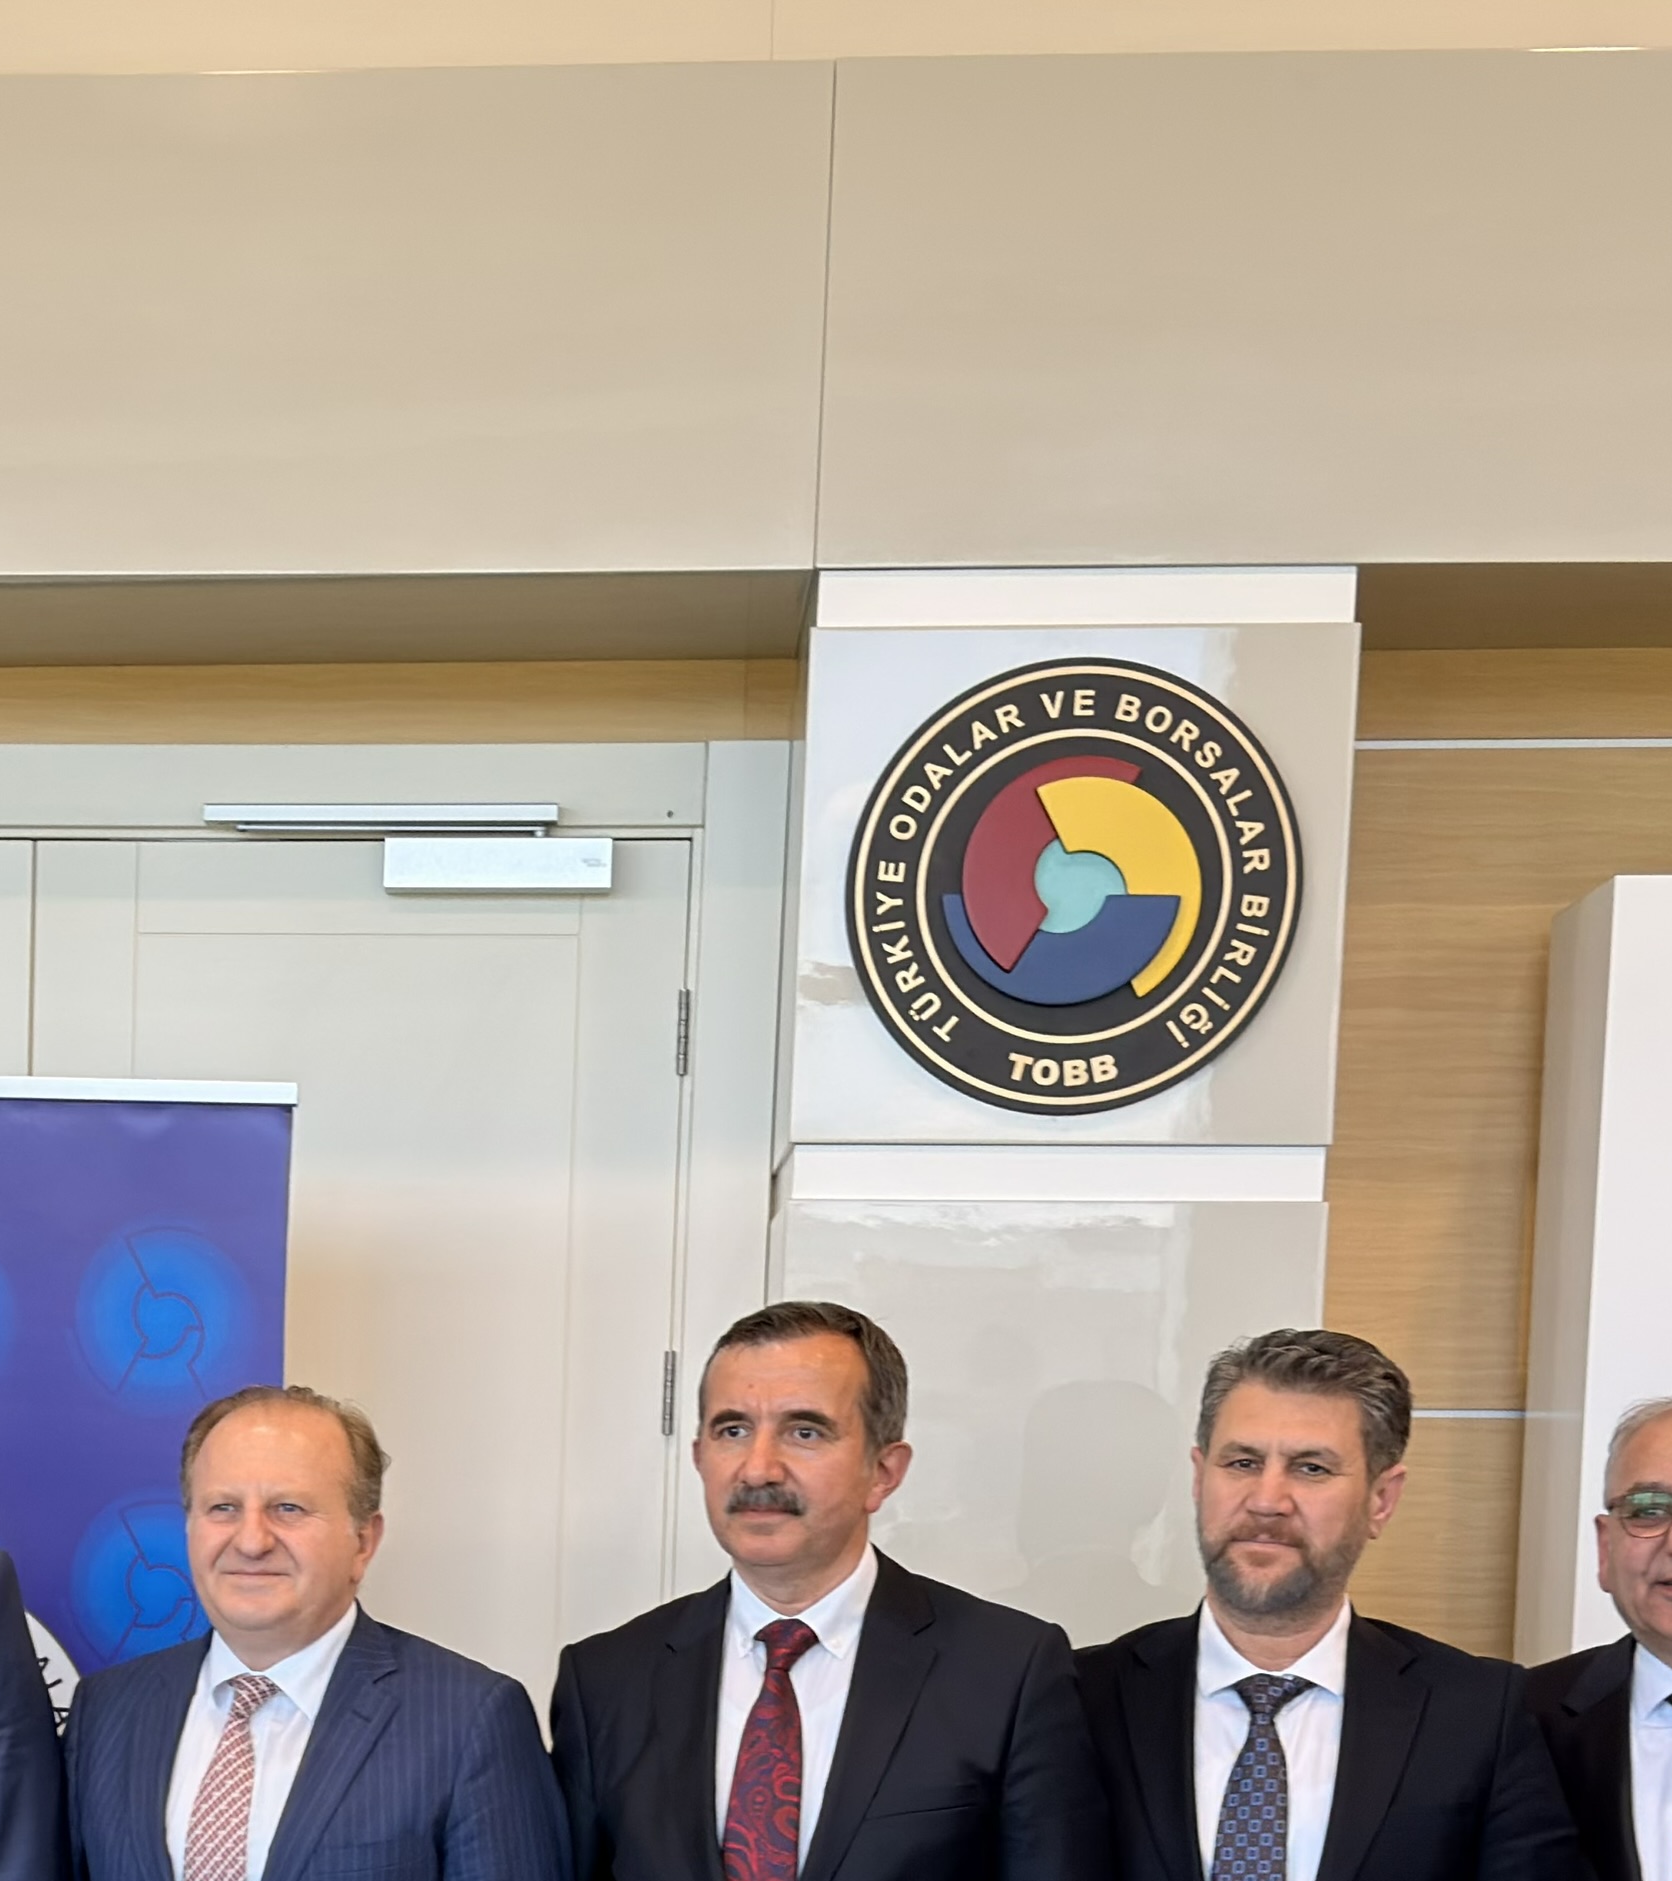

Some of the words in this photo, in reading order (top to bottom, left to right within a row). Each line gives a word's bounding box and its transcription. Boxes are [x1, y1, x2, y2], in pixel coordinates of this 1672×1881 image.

[889, 703, 1025, 840] ODALAR
[1040, 689, 1096, 719] VE
[1115, 693, 1271, 875] BORSALAR
[872, 860, 960, 1043] TÜRKİYE
[1164, 894, 1271, 1049] BİRLİĞİ
[1008, 1053, 1119, 1087] TOBB
